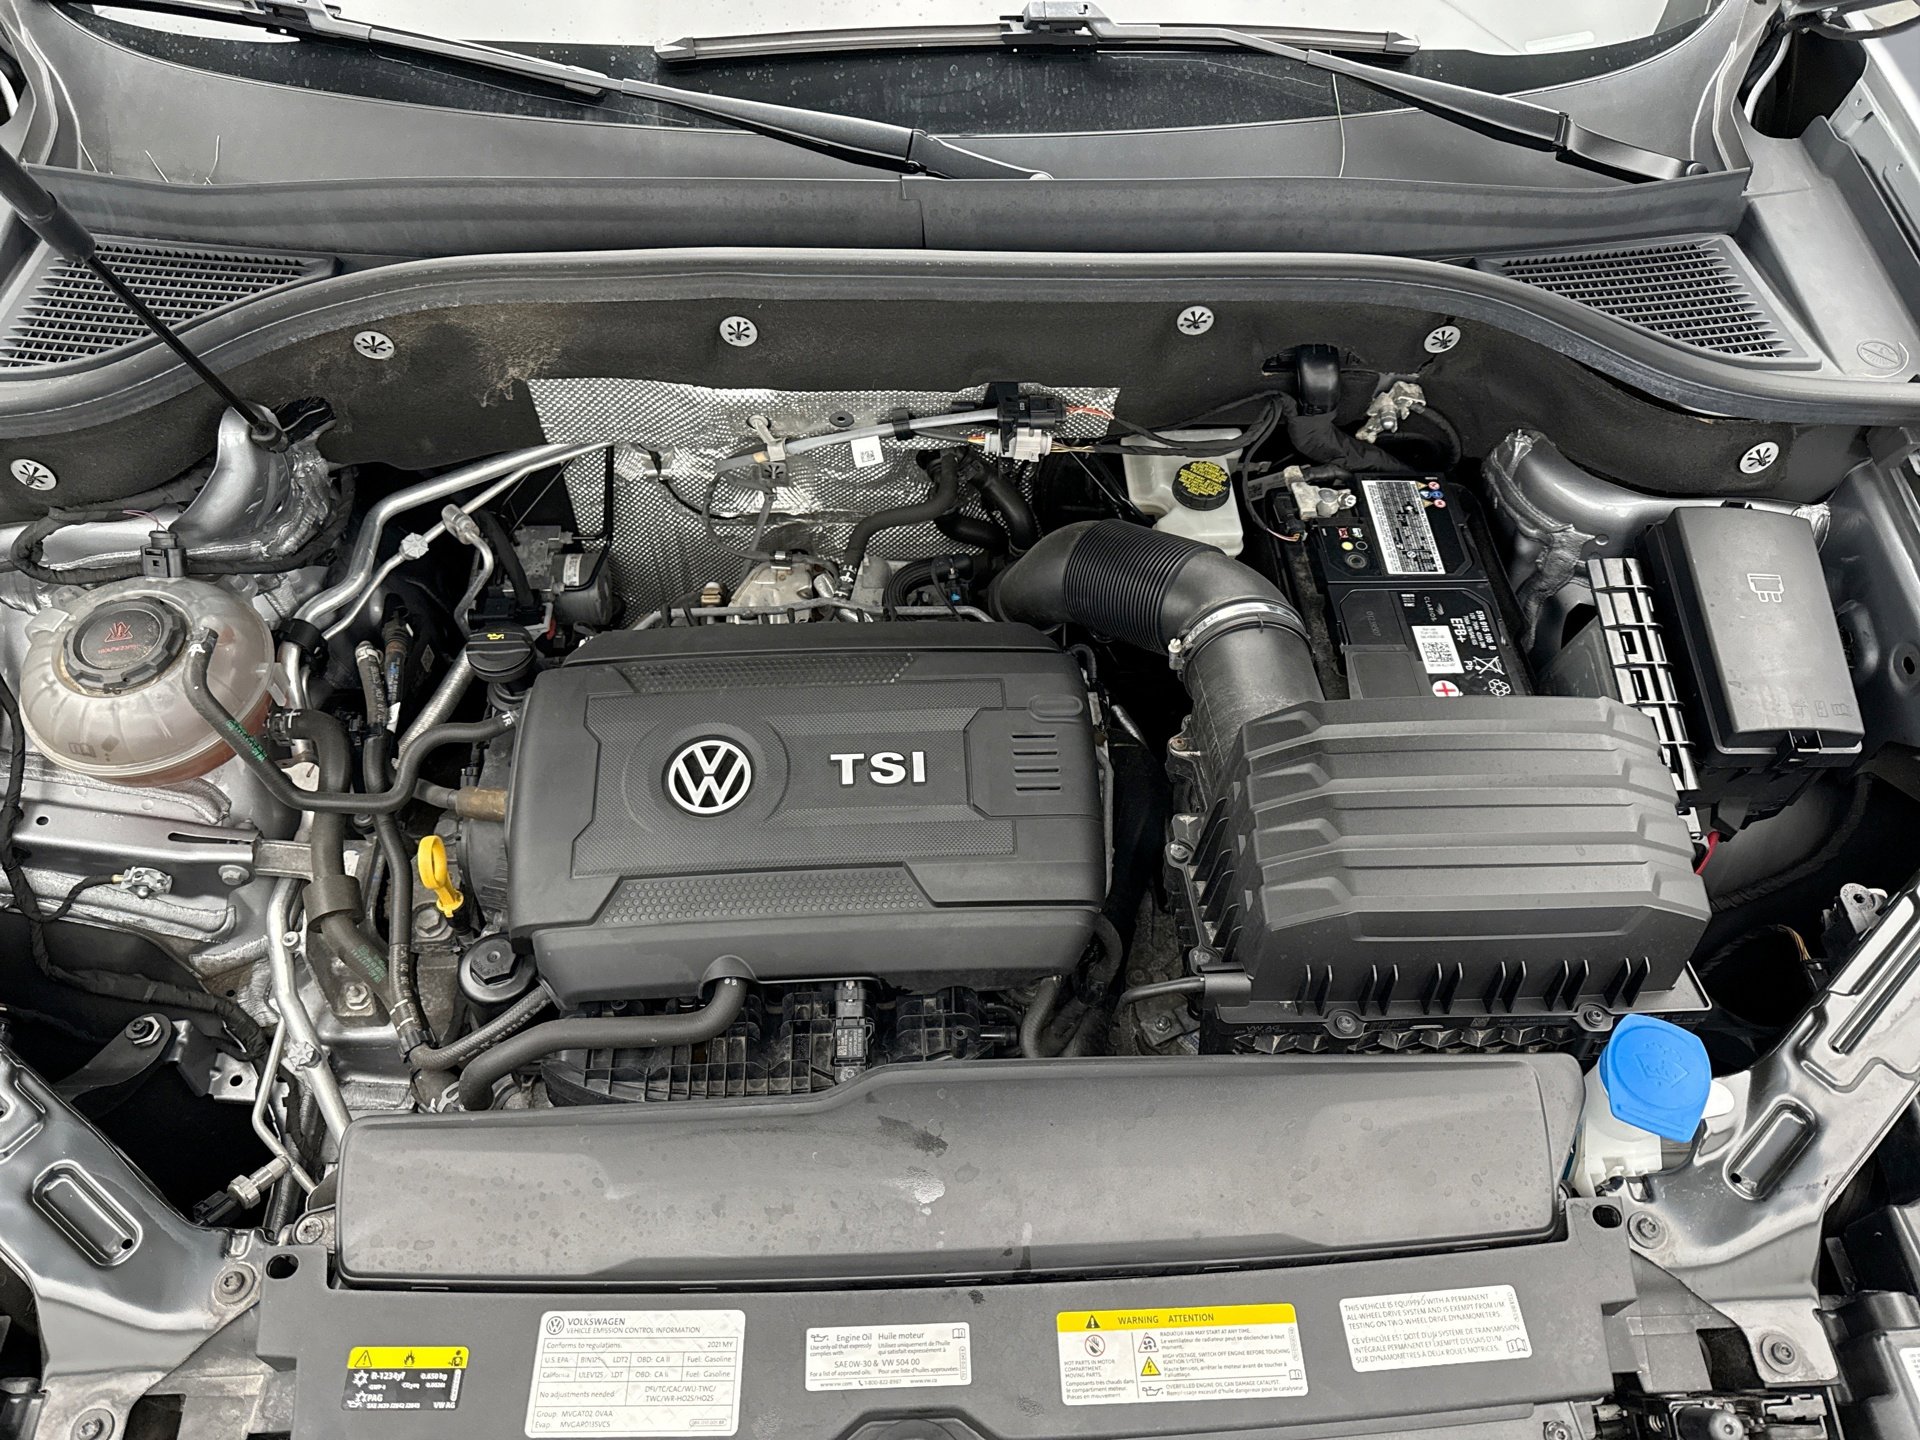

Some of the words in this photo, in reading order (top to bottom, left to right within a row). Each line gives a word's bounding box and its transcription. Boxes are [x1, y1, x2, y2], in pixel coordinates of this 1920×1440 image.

[1450, 618, 1467, 643] EFB+
[1464, 660, 1474, 670] Pb
[830, 751, 926, 785] TSI
[667, 739, 753, 816] VW
[1344, 1304, 1360, 1312] THIS
[1359, 1302, 1387, 1310] VEHICLE
[1426, 1297, 1445, 1305] WITH
[1450, 1293, 1489, 1303] PERMANENT
[1346, 1311, 1382, 1321] ALL-WHEEL
[1382, 1310, 1402, 1318] DRIVE
[1402, 1308, 1427, 1316] SYSTEM
[1427, 1306, 1442, 1314] AND
[1449, 1304, 1474, 1312] EXEMPT
[1474, 1302, 1494, 1310] FROM
[567, 1318, 626, 1326] VOLKSWAGEN
[1117, 1315, 1159, 1325] WARNING
[1168, 1313, 1215, 1323] ATTENTION
[1348, 1321, 1375, 1330] TESTING
[1375, 1320, 1387, 1328] ON
[1387, 1317, 1427, 1327] TWO-WHEEL
[1428, 1315, 1448, 1323] DRIVE
[836, 1333, 861, 1344] Engine
[878, 1332, 897, 1340] Huile
[1351, 1337, 1360, 1345] CE
[1465, 1327, 1474, 1335] DE
[1474, 1323, 1520, 1334] TRANSMISSION
[1387, 1341, 1424, 1351] PERMANENT
[1355, 1355, 1370, 1363] SUR
[1427, 1349, 1445, 1357] DEUX
[1445, 1347, 1467, 1356] ROUES
[834, 1360, 848, 1368] SAE
[849, 1360, 872, 1368] 0W-30
[873, 1359, 878, 1367] &
[882, 1359, 894, 1367] VW
[896, 1358, 909, 1366] 504
[366, 1394, 384, 1402] PAG
[550, 1391, 590, 1400] adjustments
